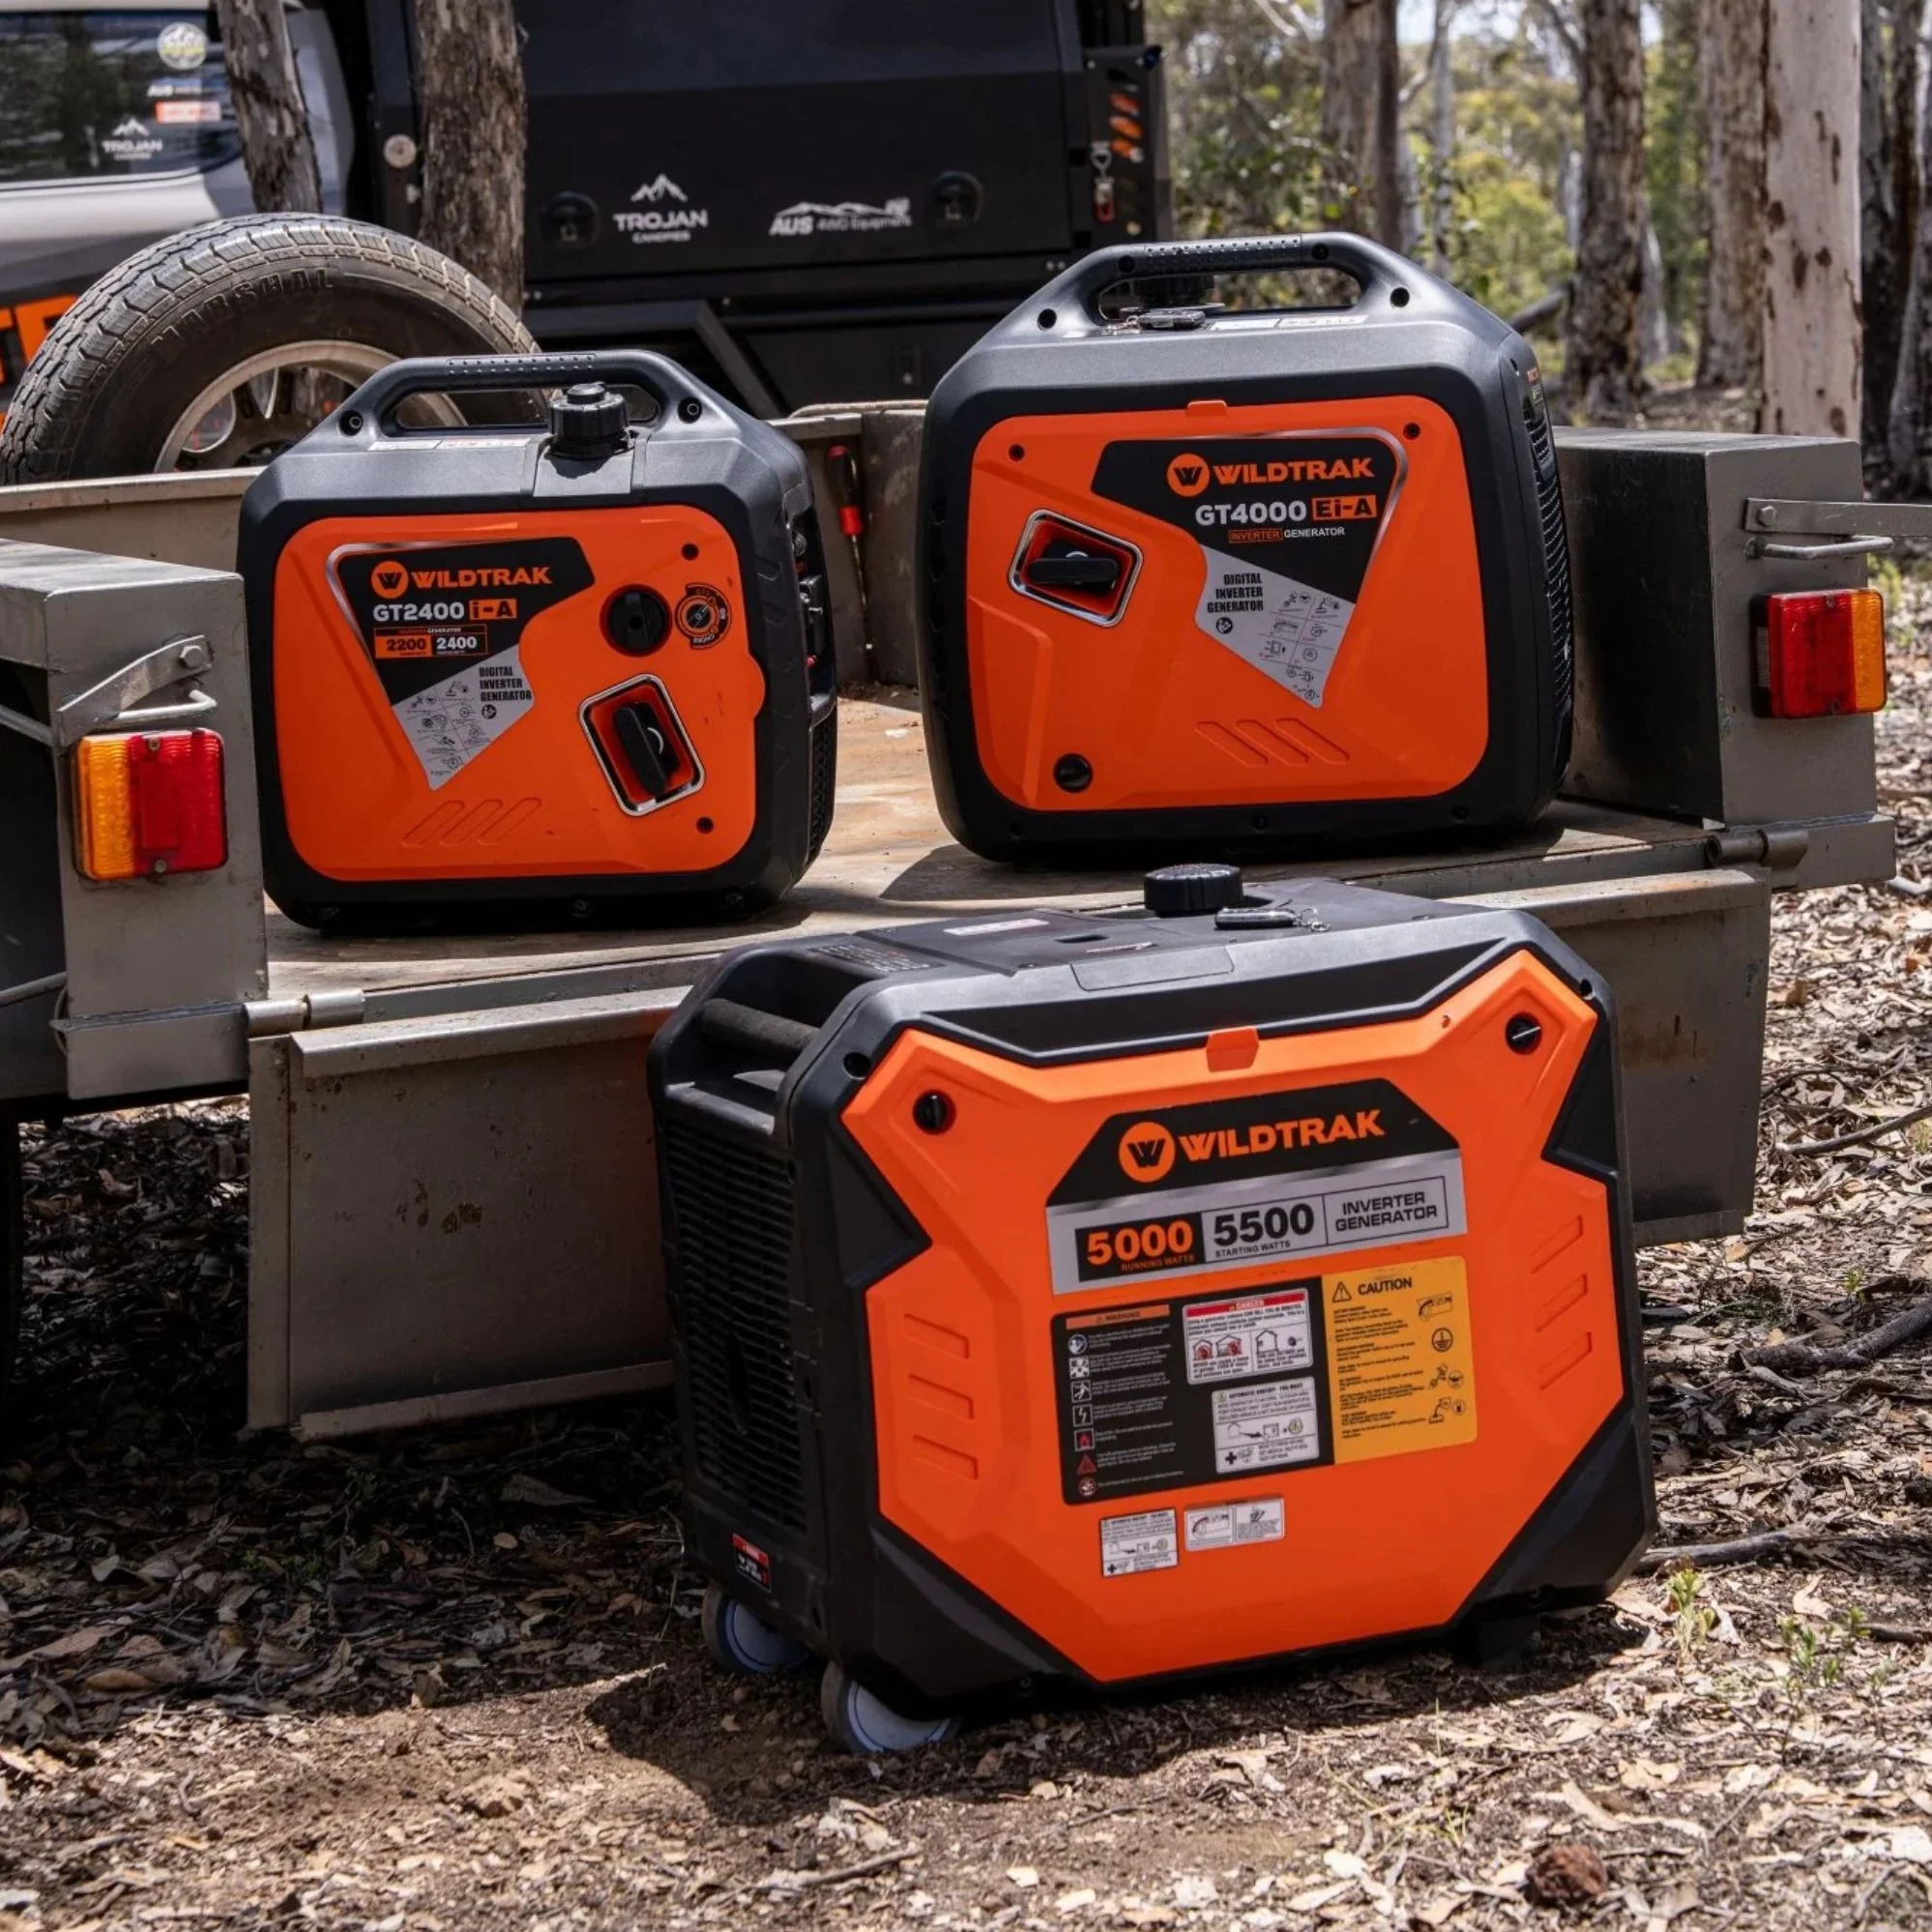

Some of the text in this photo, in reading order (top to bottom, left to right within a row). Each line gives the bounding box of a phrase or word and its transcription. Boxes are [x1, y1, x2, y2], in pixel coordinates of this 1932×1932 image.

[613, 209, 708, 231] TROJAN
[769, 215, 813, 236] AUS
[1213, 457, 1375, 485] WILDTRAK
[1195, 500, 1307, 526] GT4000
[1231, 526, 1346, 541] INVERTER GENERATOR
[411, 567, 552, 589] WILDTRAK
[1223, 572, 1262, 586] DIGITAL
[1215, 586, 1263, 600] INVERTER
[373, 601, 465, 622] GT2400
[1207, 600, 1264, 613] GENERATOR
[386, 636, 478, 652] 2200 2400
[479, 665, 513, 677] DIGITAL
[480, 678, 523, 689] INVERTER
[481, 690, 532, 701] GENERATOR
[1179, 1108, 1385, 1161] WILDTRAK
[1342, 1191, 1426, 1215] INVERTER
[1335, 1205, 1438, 1232] GENERATOR
[1086, 1203, 1315, 1266] 5000 5500
[1215, 1240, 1291, 1258] STARTING WATTS
[1121, 1253, 1195, 1272] RUNNING WATTS
[1358, 1276, 1413, 1296] CAUTION
